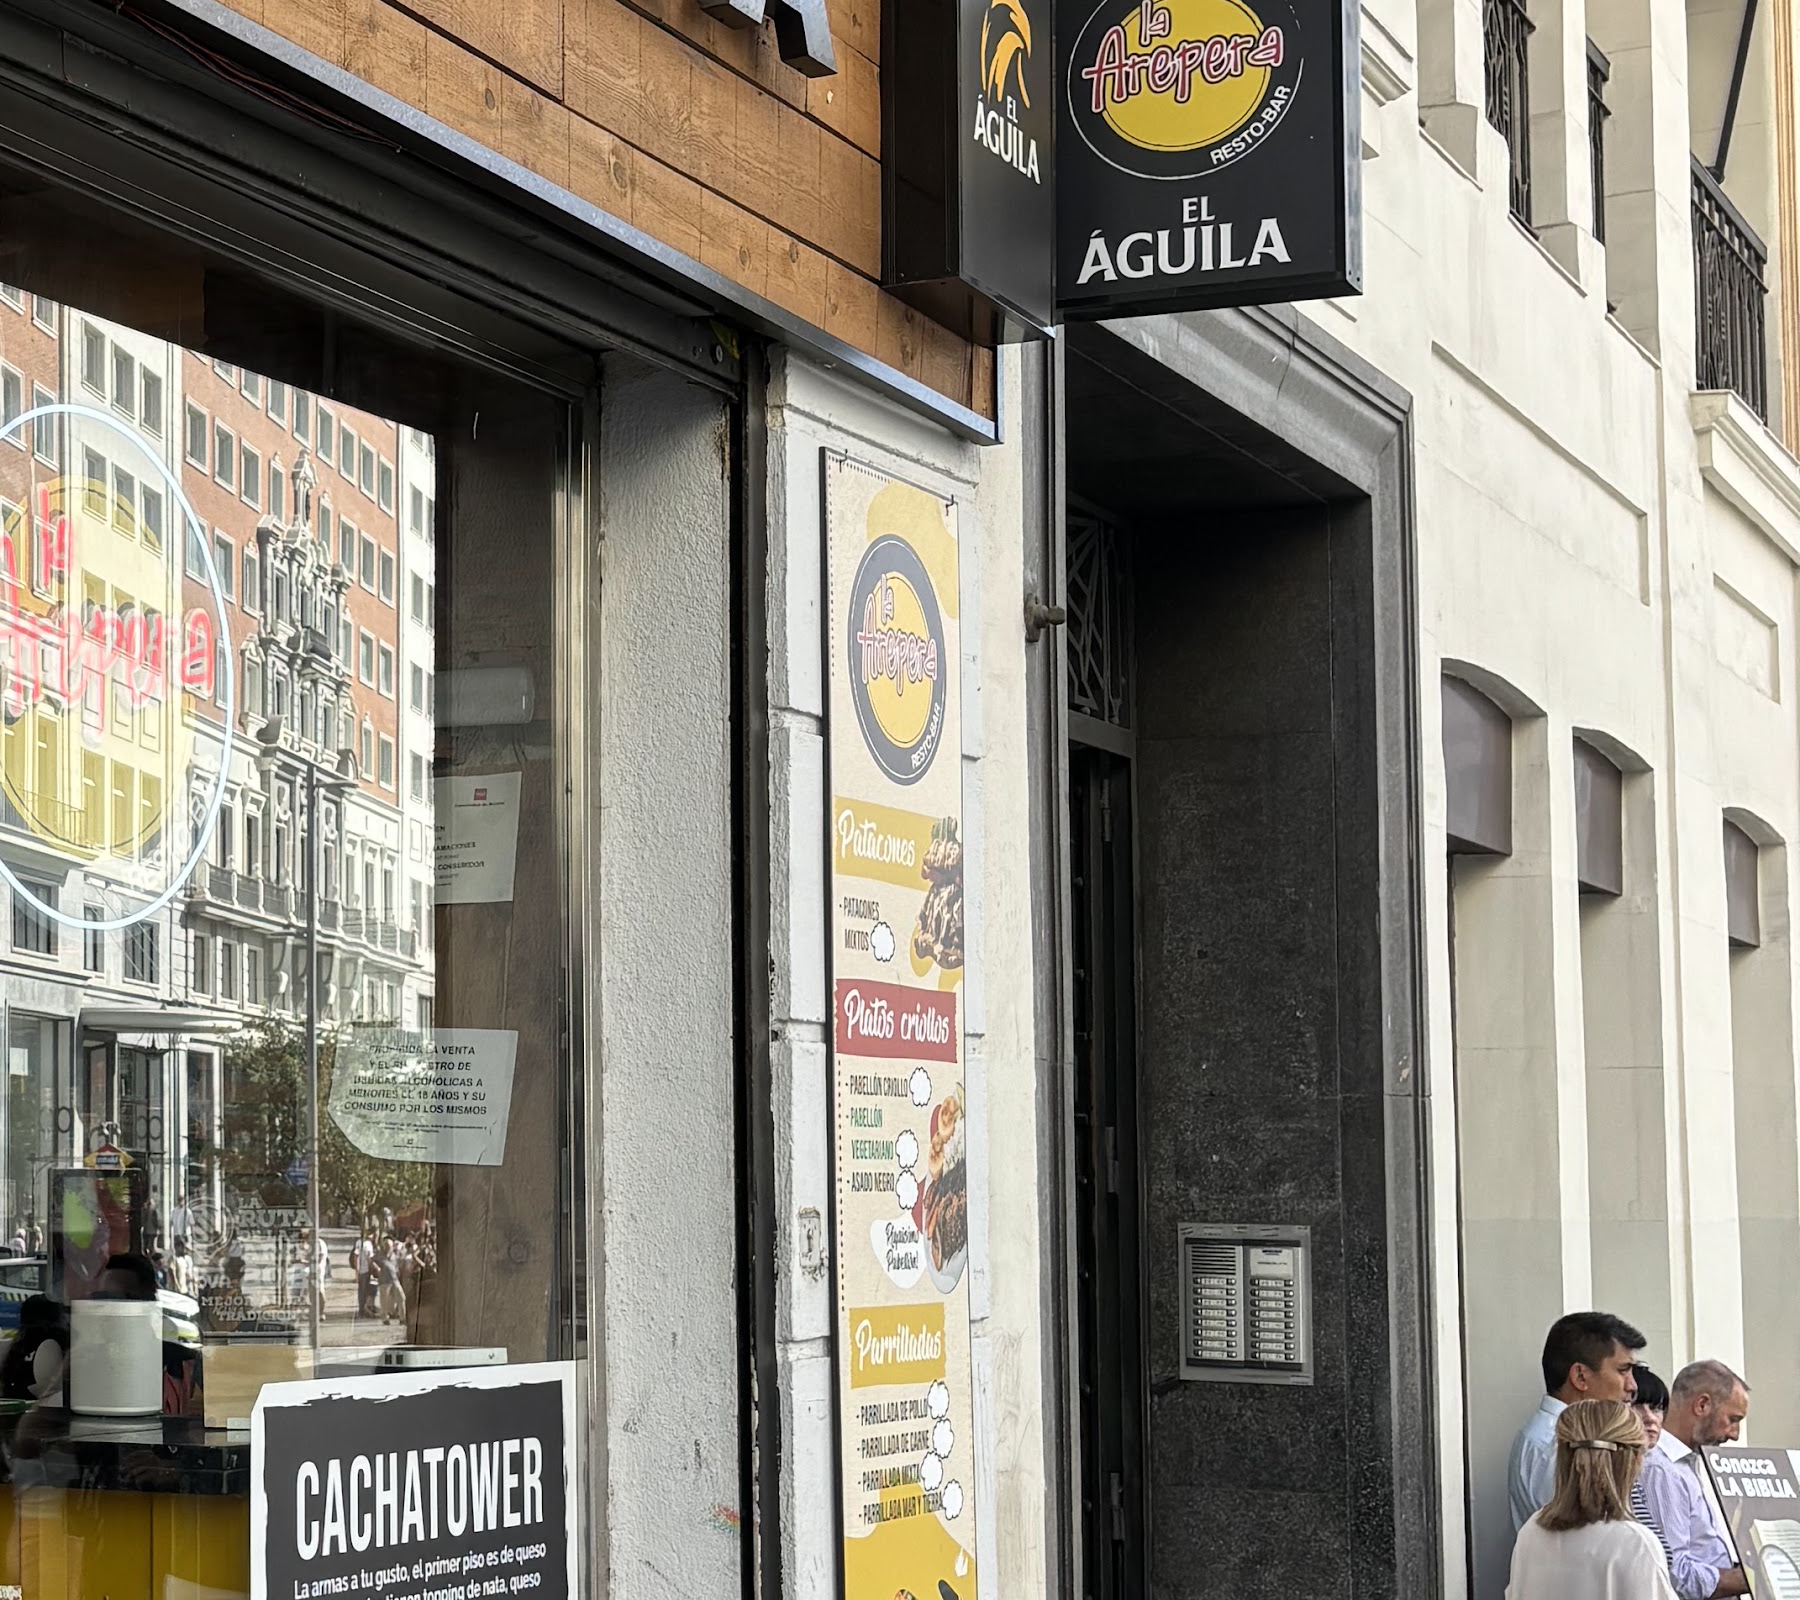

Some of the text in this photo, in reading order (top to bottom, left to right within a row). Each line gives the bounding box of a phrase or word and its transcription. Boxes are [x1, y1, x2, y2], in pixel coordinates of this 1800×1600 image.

[1140, 0, 1172, 45] la
[1082, 24, 1285, 114] Arepera
[1007, 97, 1020, 124] EL
[1210, 83, 1291, 166] RESTO-BAR
[974, 93, 1041, 185] ÁGUILA
[1182, 197, 1216, 224] EL
[1076, 217, 1292, 285] ÁGUILA
[881, 574, 894, 623] la
[857, 592, 938, 696] Arepera
[911, 703, 941, 770] RESTO-BAR
[838, 809, 916, 870] Patacones
[844, 989, 949, 1044] Platos criollos
[441, 1045, 476, 1055] VENTA
[378, 1061, 390, 1071] EL
[458, 1062, 471, 1071] DE
[417, 1090, 429, 1100] 18
[431, 1089, 459, 1101] AÑOS
[472, 1092, 486, 1101] SU
[476, 1078, 483, 1087] A
[344, 1101, 487, 1115] CONSUMO POR LOS MISMOS
[851, 1172, 873, 1192] ASADO
[238, 1209, 314, 1227] RUTA
[855, 1318, 943, 1372] Parrilladas
[861, 1400, 908, 1426] PARRILLADA DE
[862, 1434, 900, 1459] PARRILLADA
[901, 1432, 909, 1453] DE
[1709, 1453, 1777, 1476] Conozca
[862, 1467, 901, 1492] PARRILLADA
[1717, 1476, 1798, 1499] LA BIBLIA
[296, 1437, 544, 1560] CACHATOWER
[863, 1499, 902, 1525] PARRILLADA
[294, 1542, 546, 1599] La armas a tu gusto, el primer piso es de queso
[466, 1579, 481, 1599] de
[483, 1576, 508, 1597] nata,
[509, 1571, 541, 1595] queso
